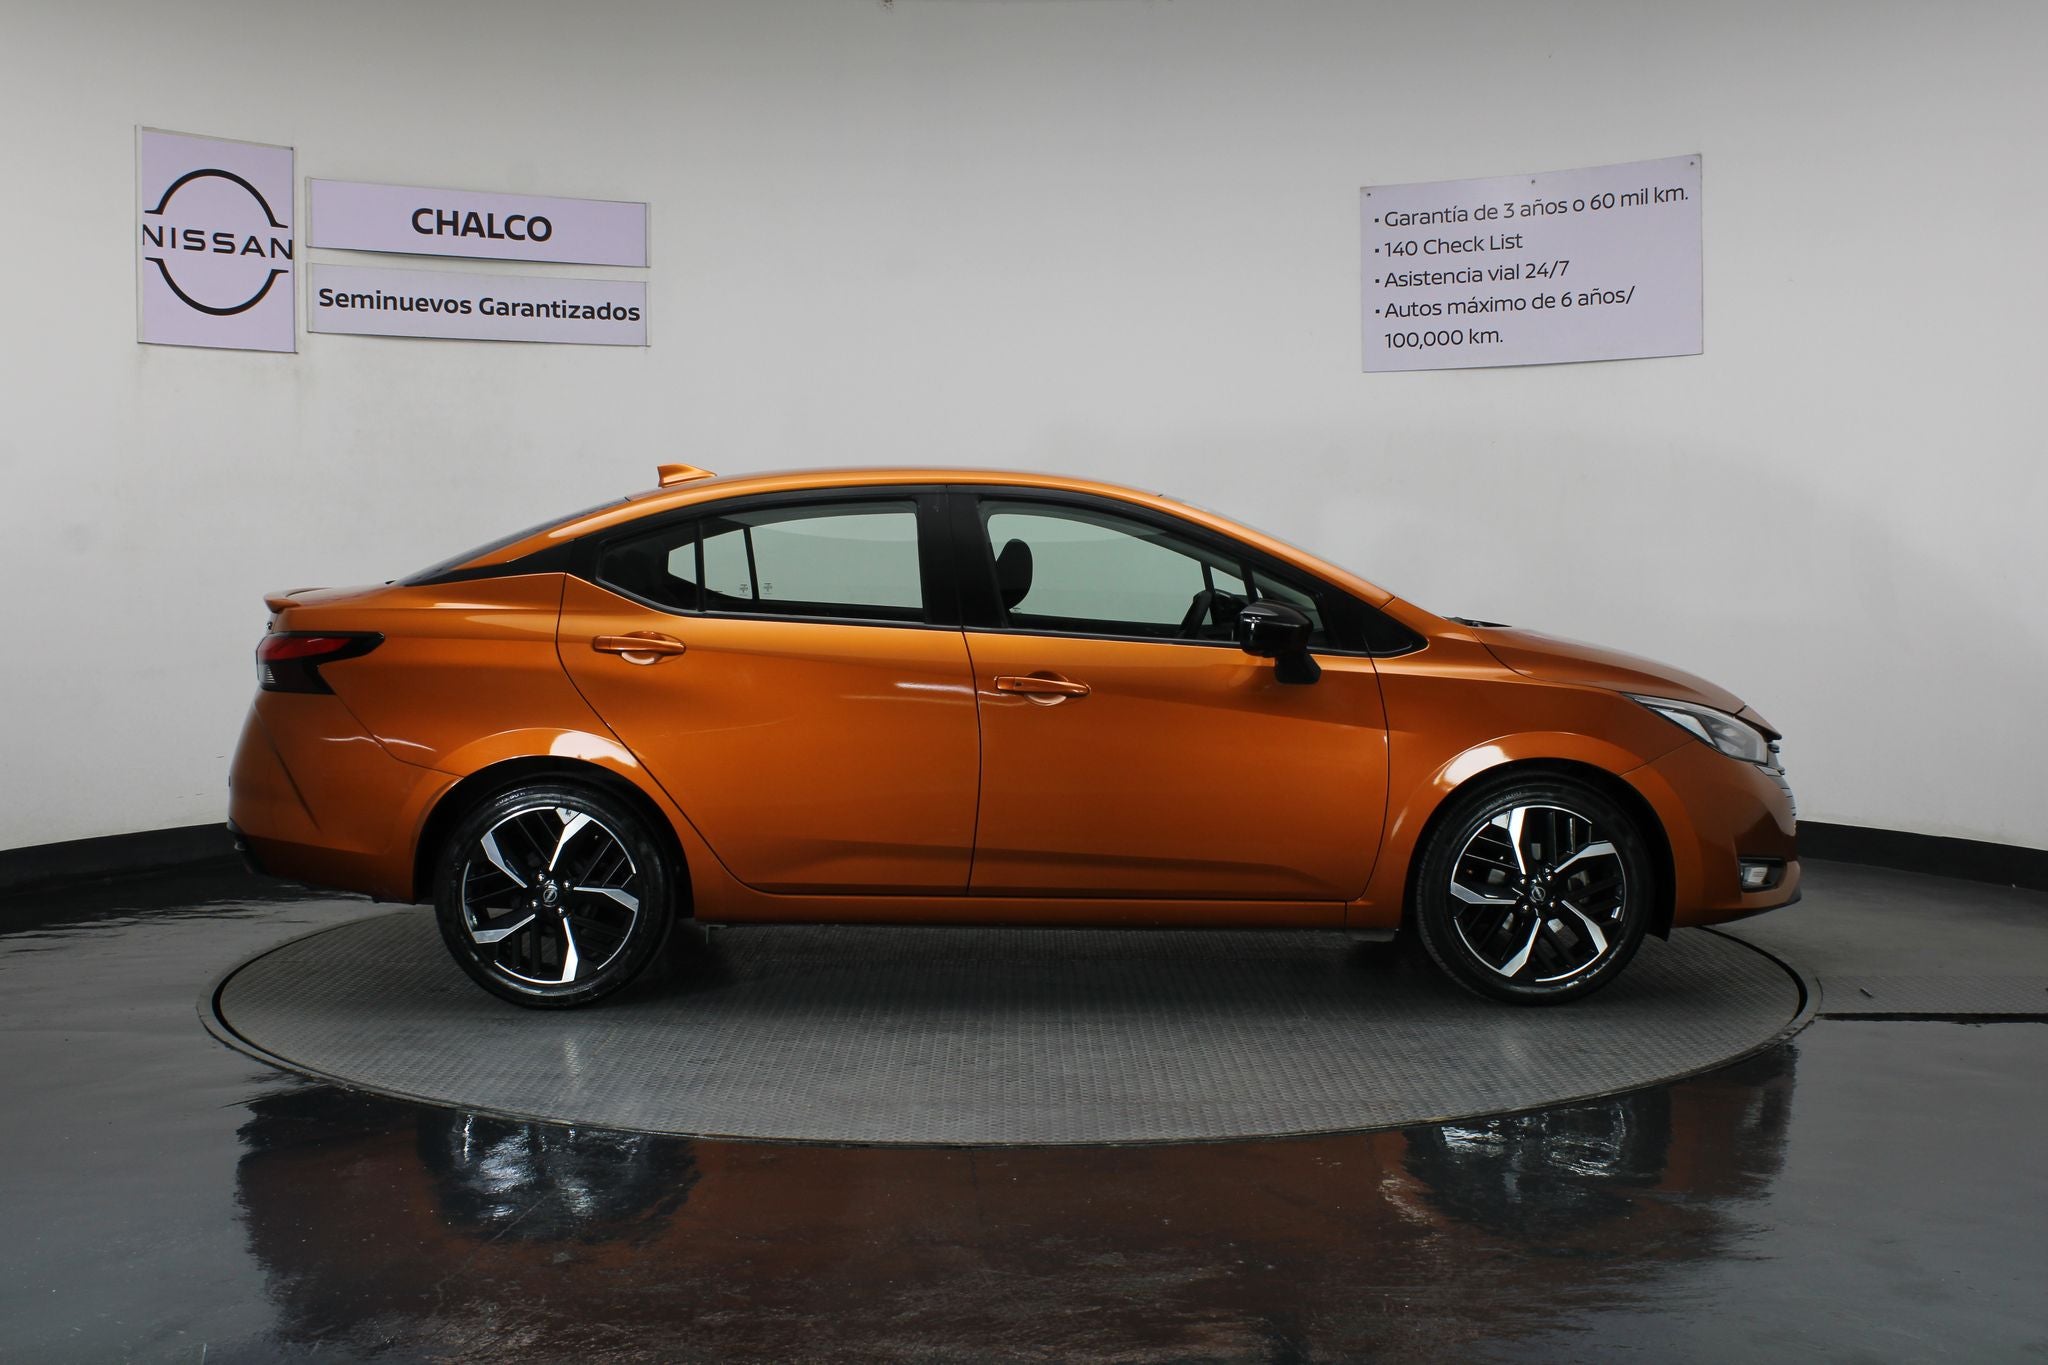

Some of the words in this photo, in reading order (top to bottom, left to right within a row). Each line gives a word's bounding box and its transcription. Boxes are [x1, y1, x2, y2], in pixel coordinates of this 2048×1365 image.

[1384, 205, 1469, 227] Garantía
[1473, 204, 1499, 221] de
[1503, 202, 1515, 219] 3
[1520, 198, 1568, 218] años
[1572, 198, 1586, 213] o
[1590, 192, 1616, 211] 60
[1620, 187, 1649, 208] mil
[1653, 186, 1689, 204] km.
[142, 223, 293, 260] NISSAN
[411, 207, 553, 243] CHALCO
[1384, 240, 1419, 258] 140
[1423, 235, 1485, 255] Check
[1489, 233, 1524, 251] List
[1384, 266, 1483, 288] Asistencia
[1487, 263, 1520, 282] vial
[1525, 259, 1570, 280] 24/7
[318, 287, 473, 315] Seminuevos
[478, 297, 641, 322] Garantizados
[1384, 302, 1443, 319] Autos
[1447, 296, 1527, 315] máximo
[1531, 292, 1556, 310] de
[1560, 291, 1573, 307] 6
[1577, 285, 1636, 307] años/
[1384, 329, 1464, 350] 100,000
[1469, 328, 1504, 345] km.
